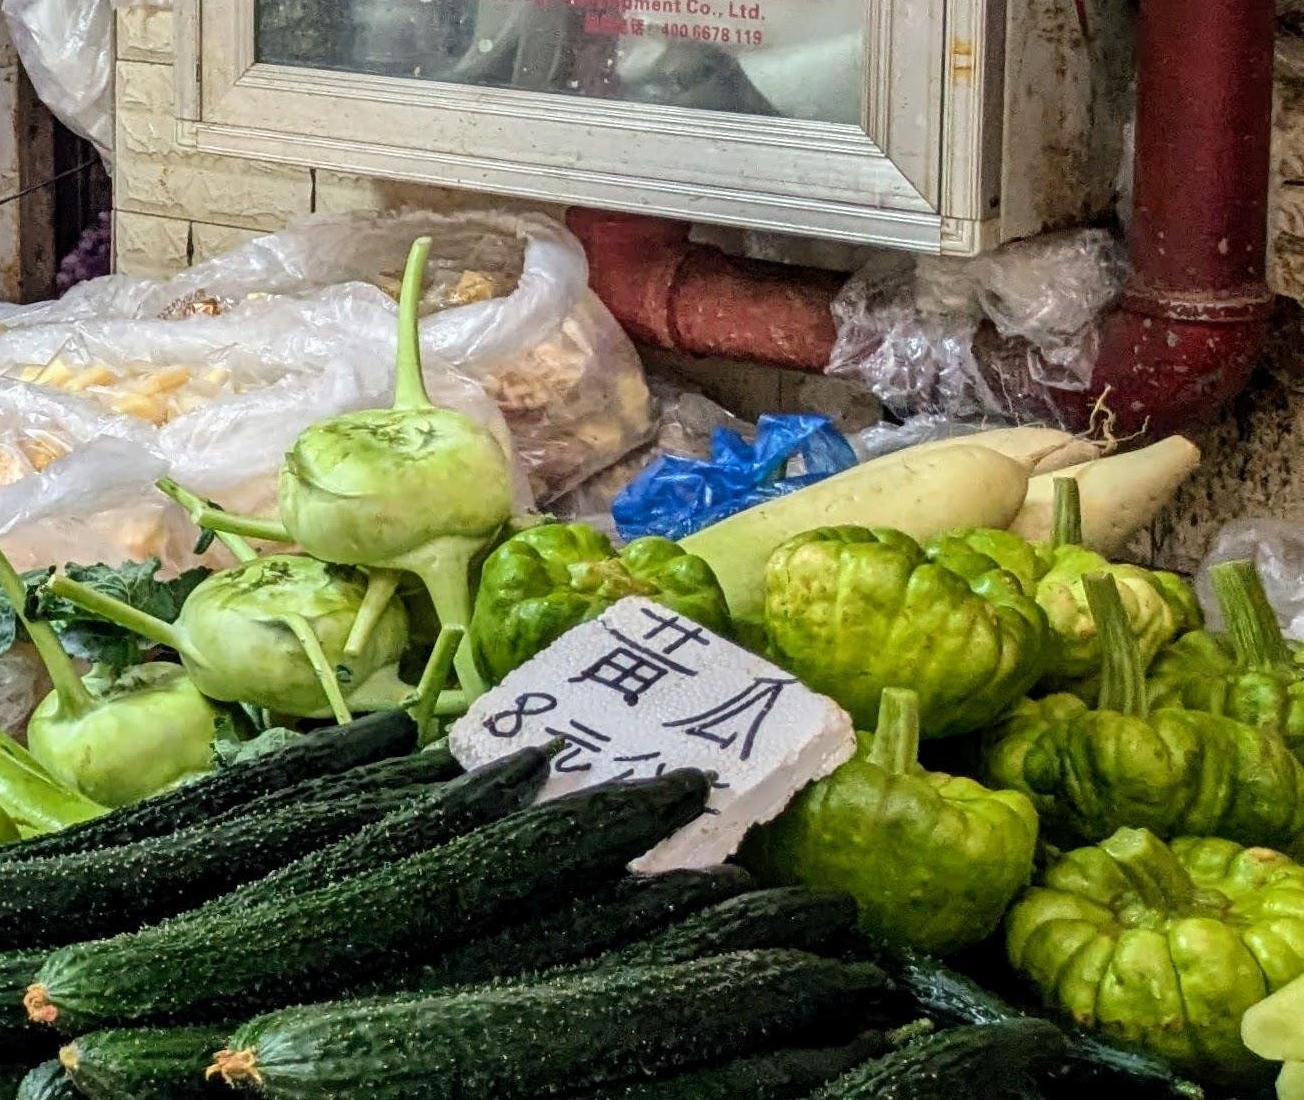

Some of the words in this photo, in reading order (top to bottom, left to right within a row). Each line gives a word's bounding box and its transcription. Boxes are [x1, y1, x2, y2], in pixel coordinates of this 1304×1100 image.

[729, 1, 766, 21] Ltd.
[662, 22, 689, 39] 400
[692, 24, 731, 43] 6678
[735, 30, 763, 46] 119
